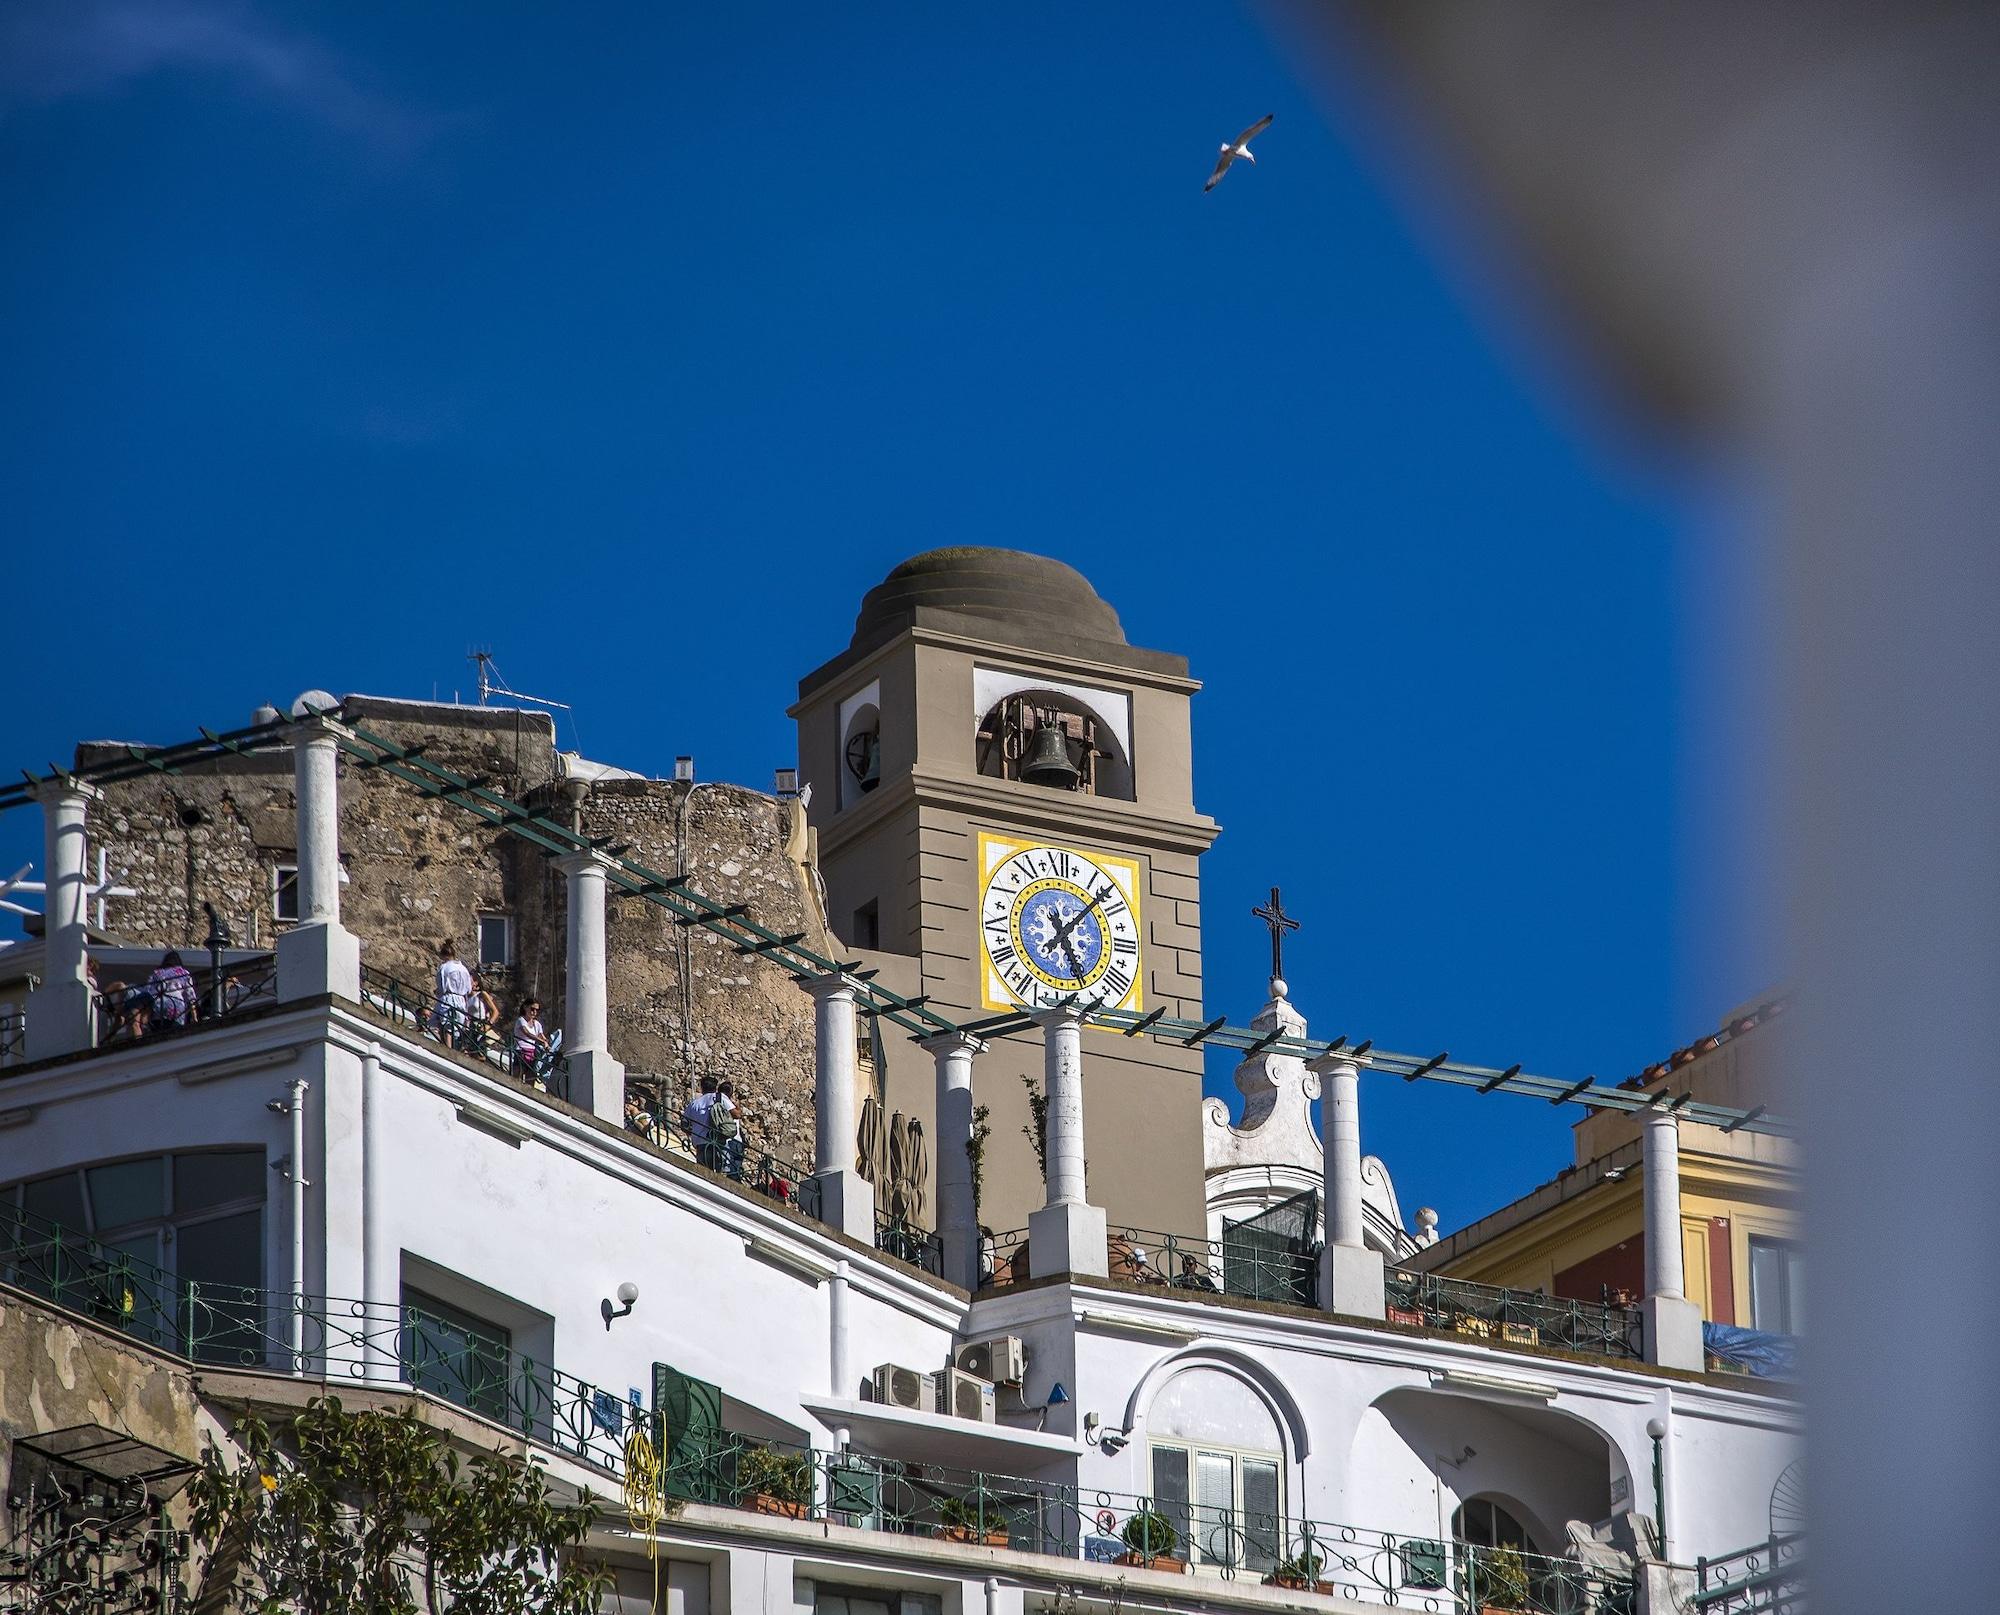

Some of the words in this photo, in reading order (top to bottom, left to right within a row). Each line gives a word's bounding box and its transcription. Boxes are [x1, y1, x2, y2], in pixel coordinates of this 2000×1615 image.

[1012, 854, 1039, 885] XI
[1046, 851, 1069, 879] XII
[991, 876, 1017, 904] X
[1086, 870, 1099, 890] I
[985, 910, 1008, 934] IX
[1104, 900, 1127, 917] II
[1113, 937, 1136, 955] III
[991, 945, 1018, 979] VIII
[1103, 965, 1130, 997] IIII
